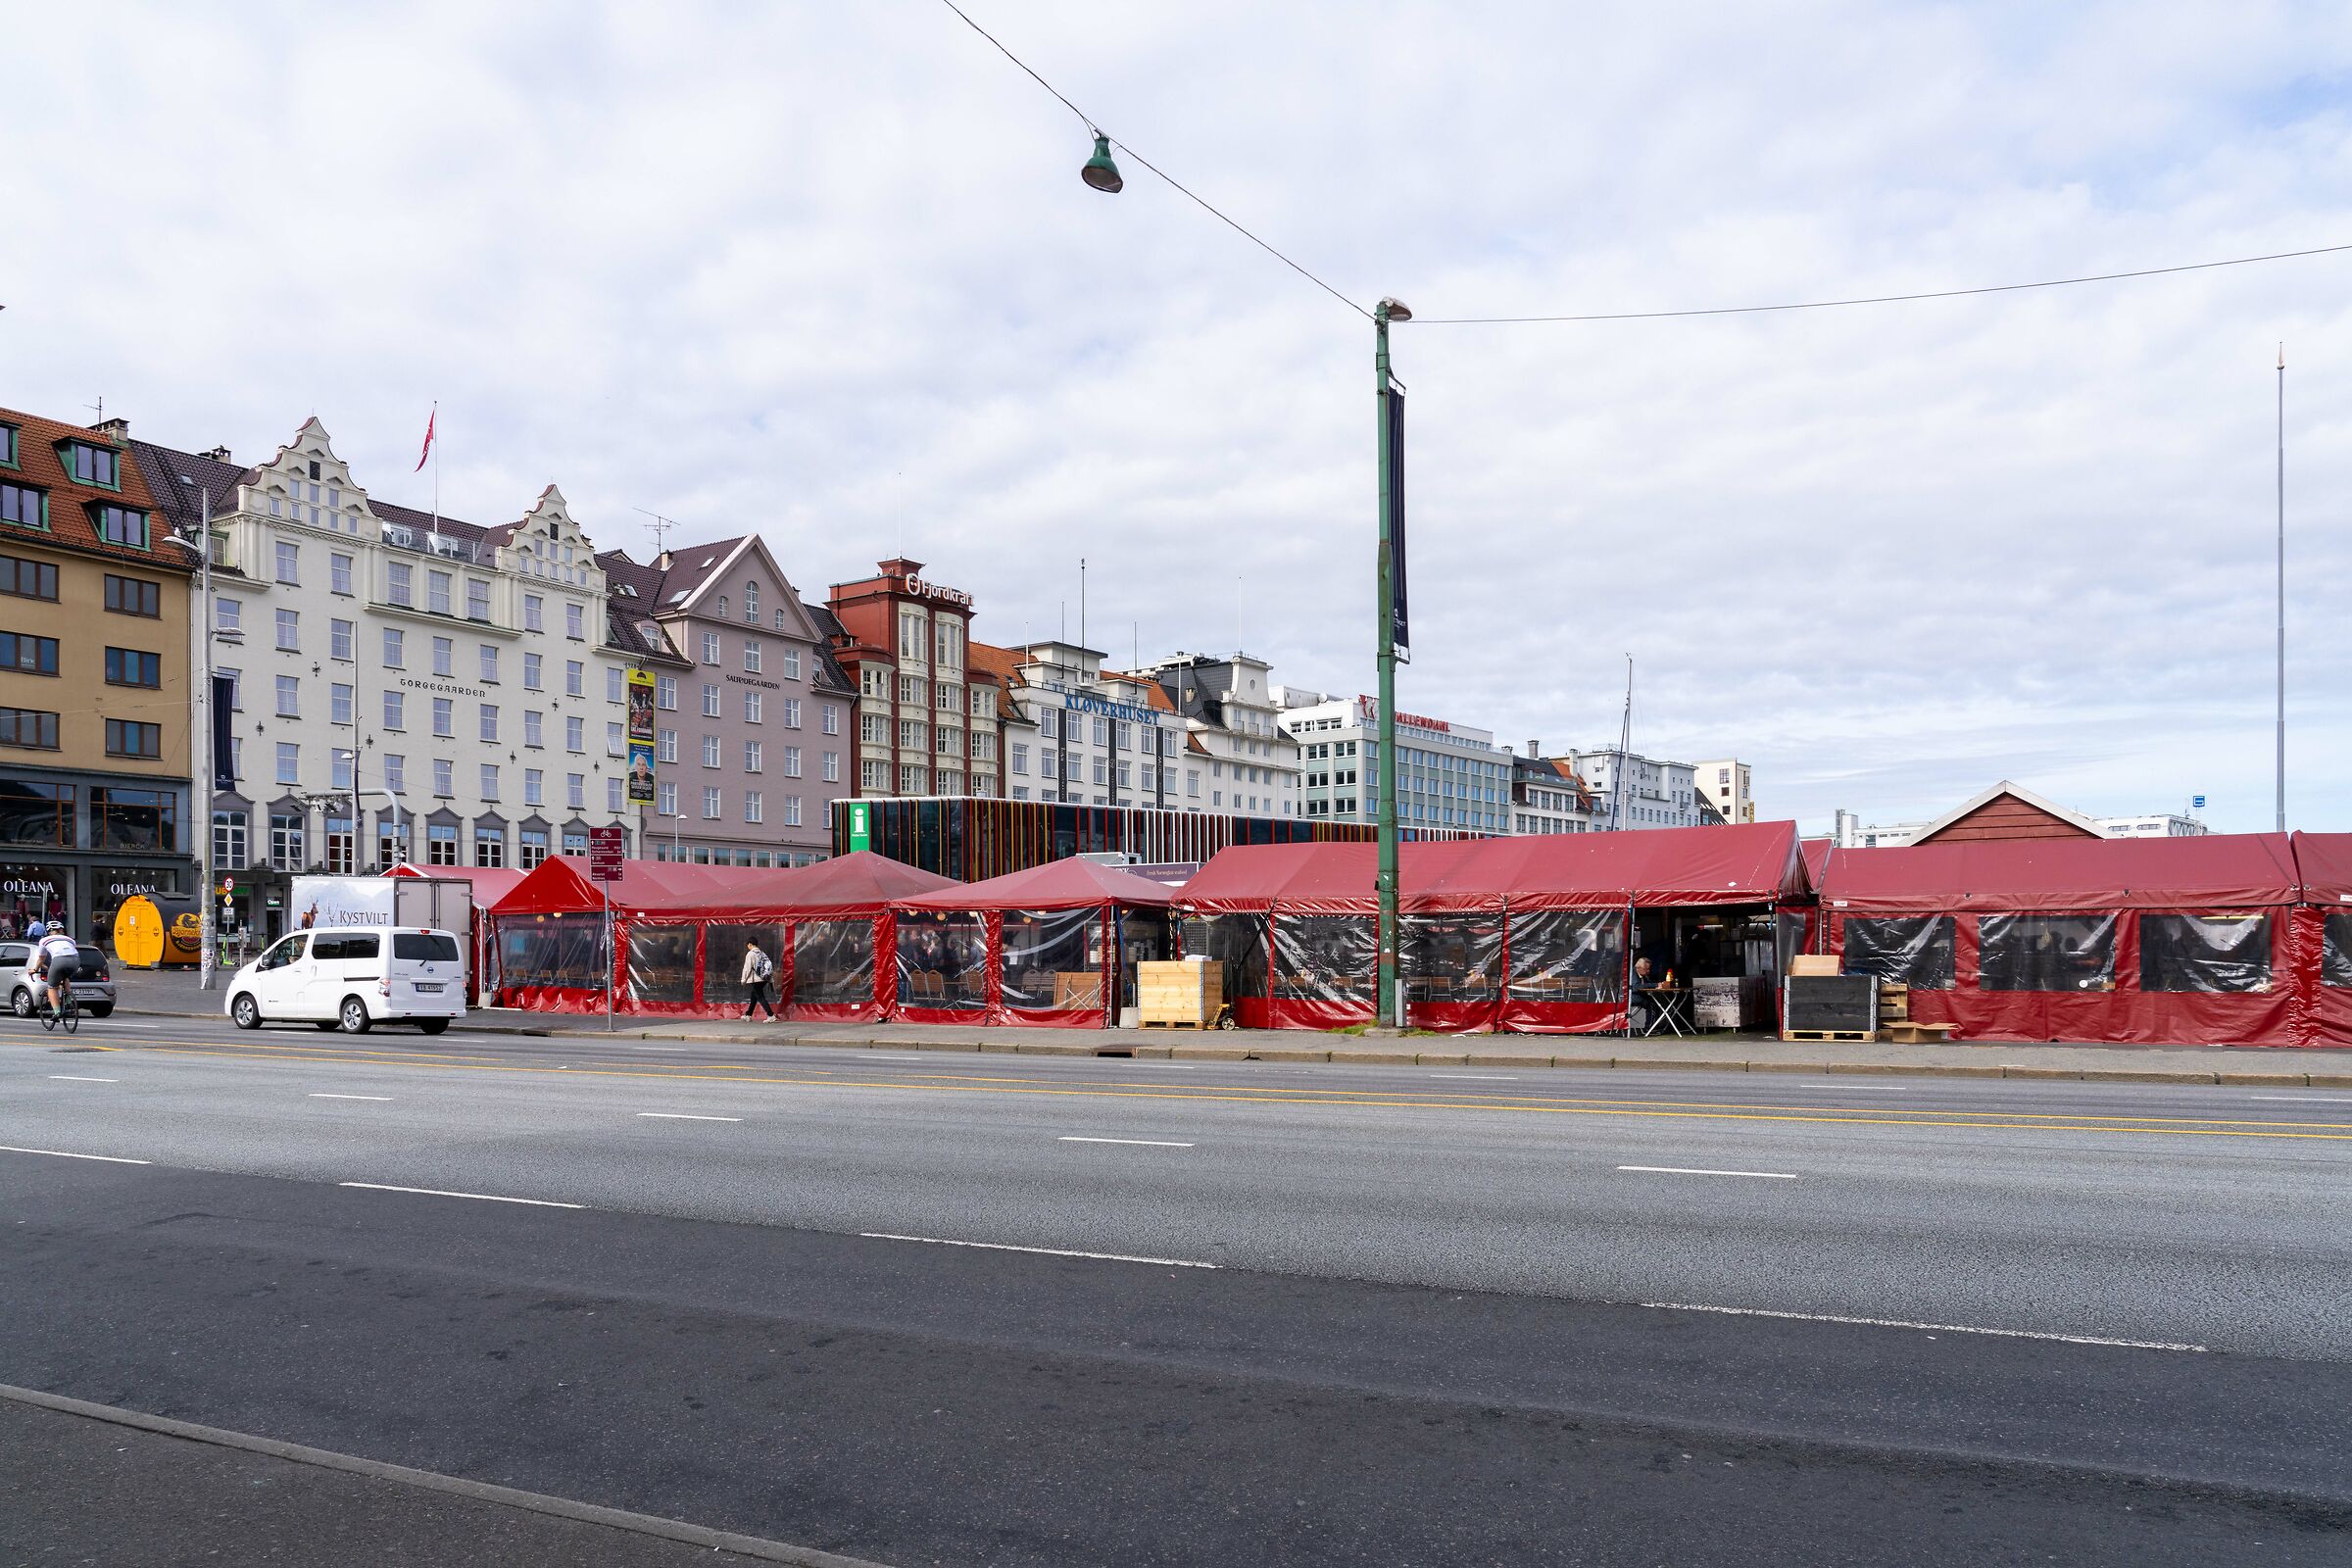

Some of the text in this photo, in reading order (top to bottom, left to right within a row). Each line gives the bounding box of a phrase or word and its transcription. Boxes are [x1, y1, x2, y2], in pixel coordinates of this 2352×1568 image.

[1064, 694, 1160, 725] KLØVERHUSET
[3, 880, 54, 894] OLEANA
[111, 883, 156, 895] OLEANA
